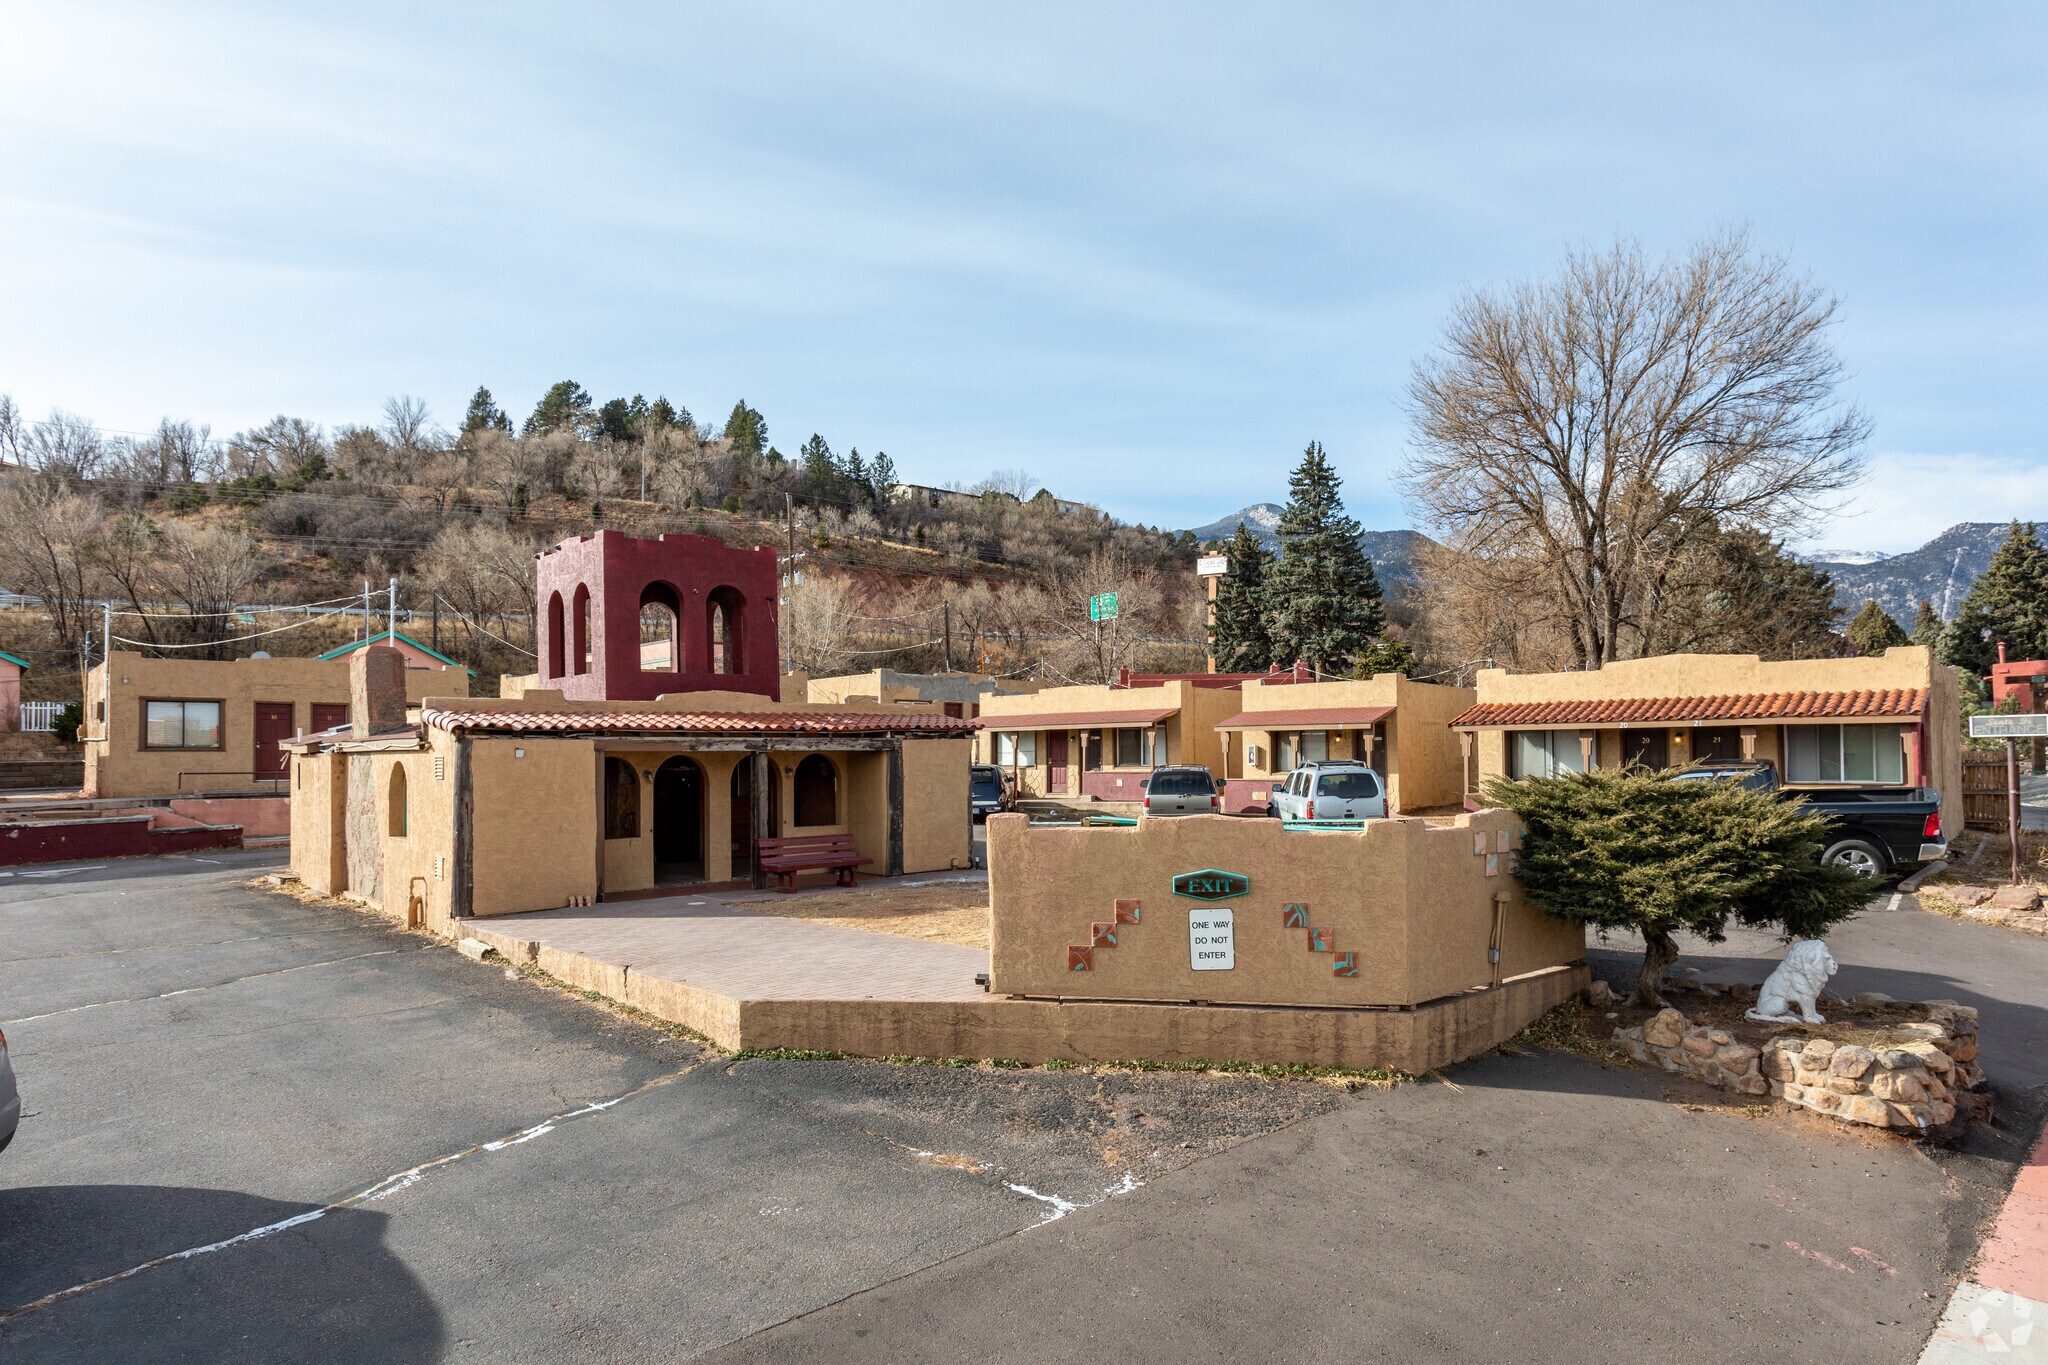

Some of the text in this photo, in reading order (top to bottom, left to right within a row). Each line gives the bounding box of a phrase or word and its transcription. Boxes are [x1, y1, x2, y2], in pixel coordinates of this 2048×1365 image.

[1973, 724, 2047, 735] ENTRANCE
[1188, 878, 1234, 893] EXIT
[1191, 921, 1210, 929] ONE
[1195, 936, 1228, 944] DO NOT
[1198, 951, 1227, 959] ENTER
